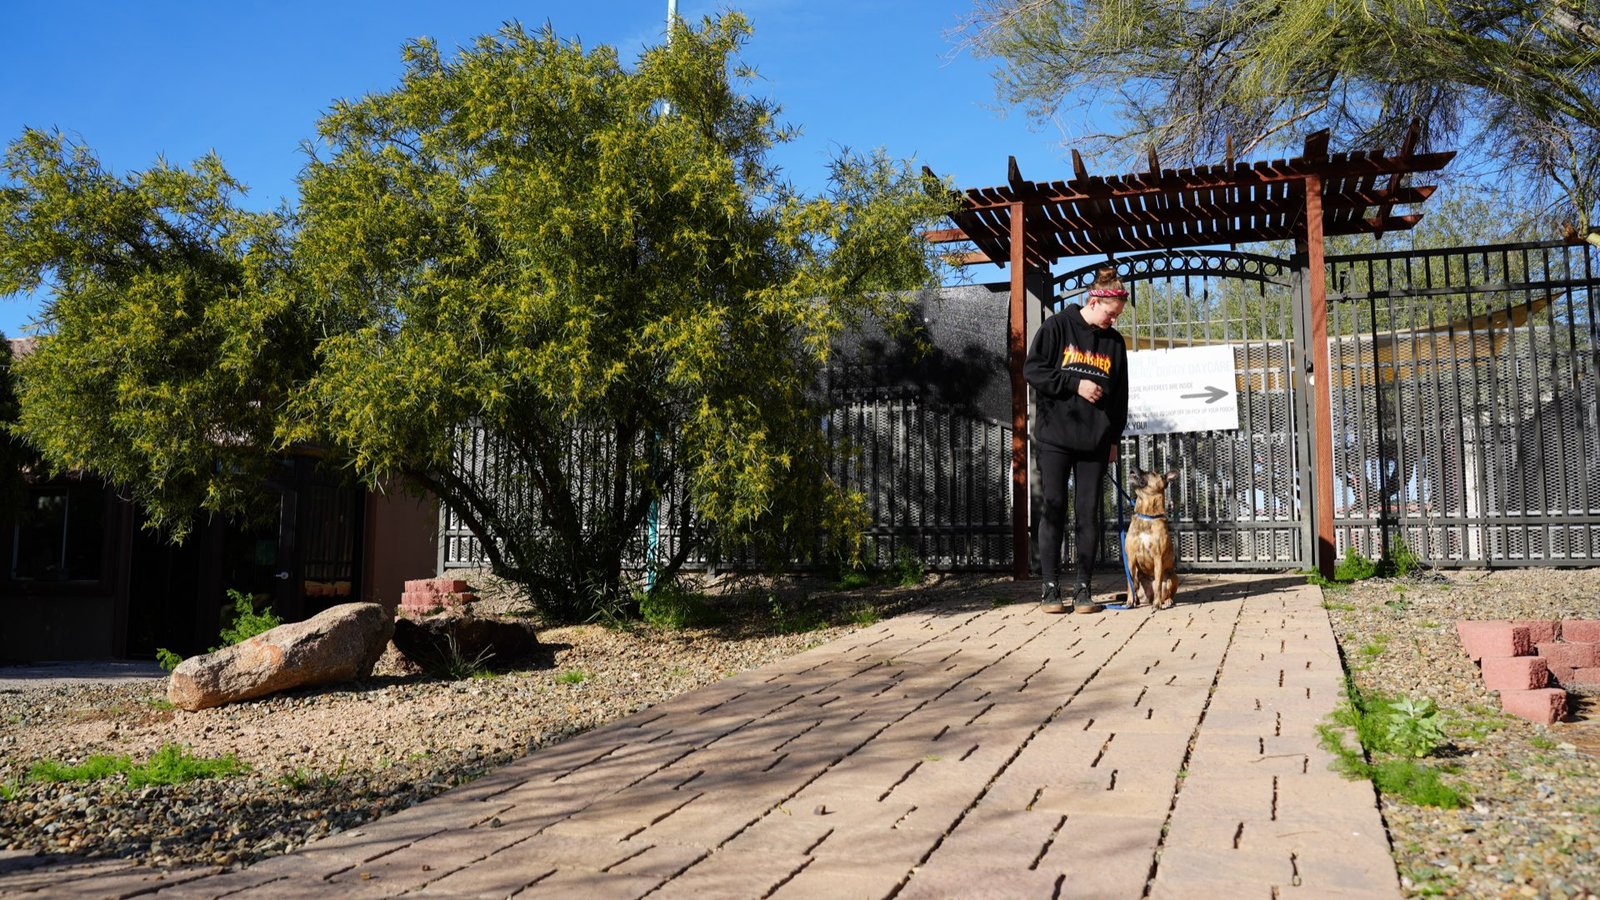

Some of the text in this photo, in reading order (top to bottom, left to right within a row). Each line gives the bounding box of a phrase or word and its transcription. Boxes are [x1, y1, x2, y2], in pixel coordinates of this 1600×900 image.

[1061, 345, 1111, 376] THRASHER
[1188, 360, 1232, 374] DAYCARE
[1133, 422, 1148, 431] YOU!
